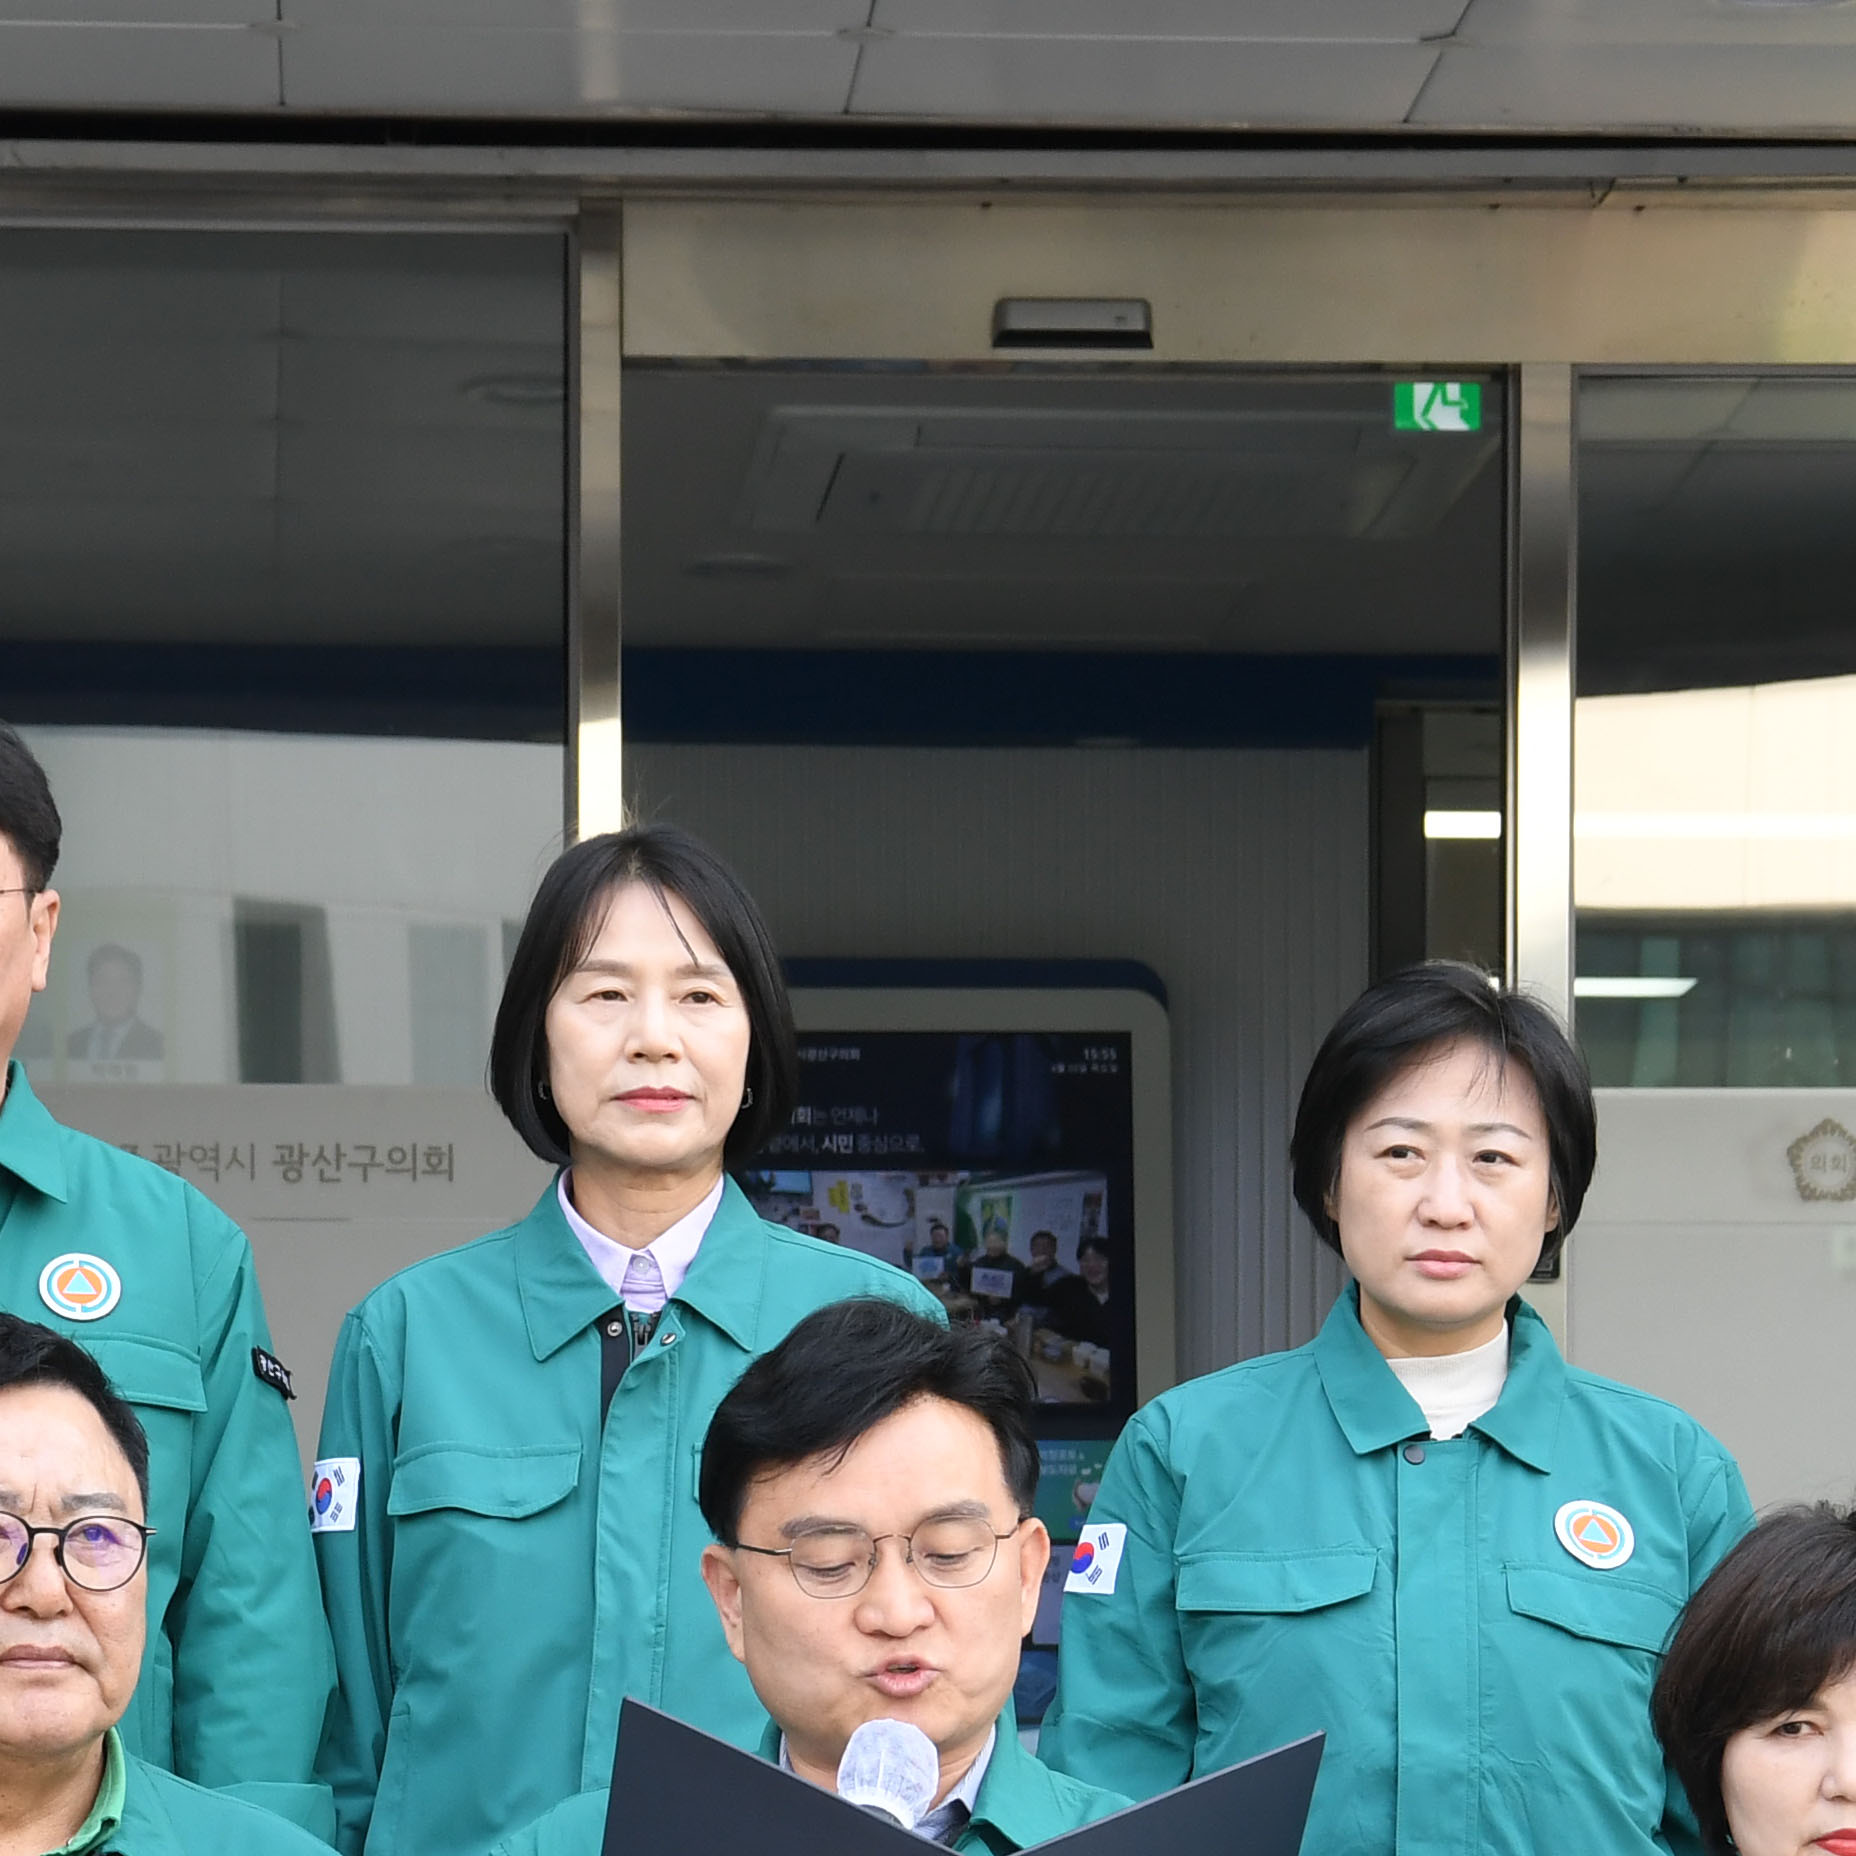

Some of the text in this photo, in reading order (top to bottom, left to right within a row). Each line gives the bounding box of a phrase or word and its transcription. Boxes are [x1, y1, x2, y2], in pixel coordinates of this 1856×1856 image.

[821, 1134, 854, 1155] 시민
[120, 1142, 455, 1184] 광역시 광산구의회
